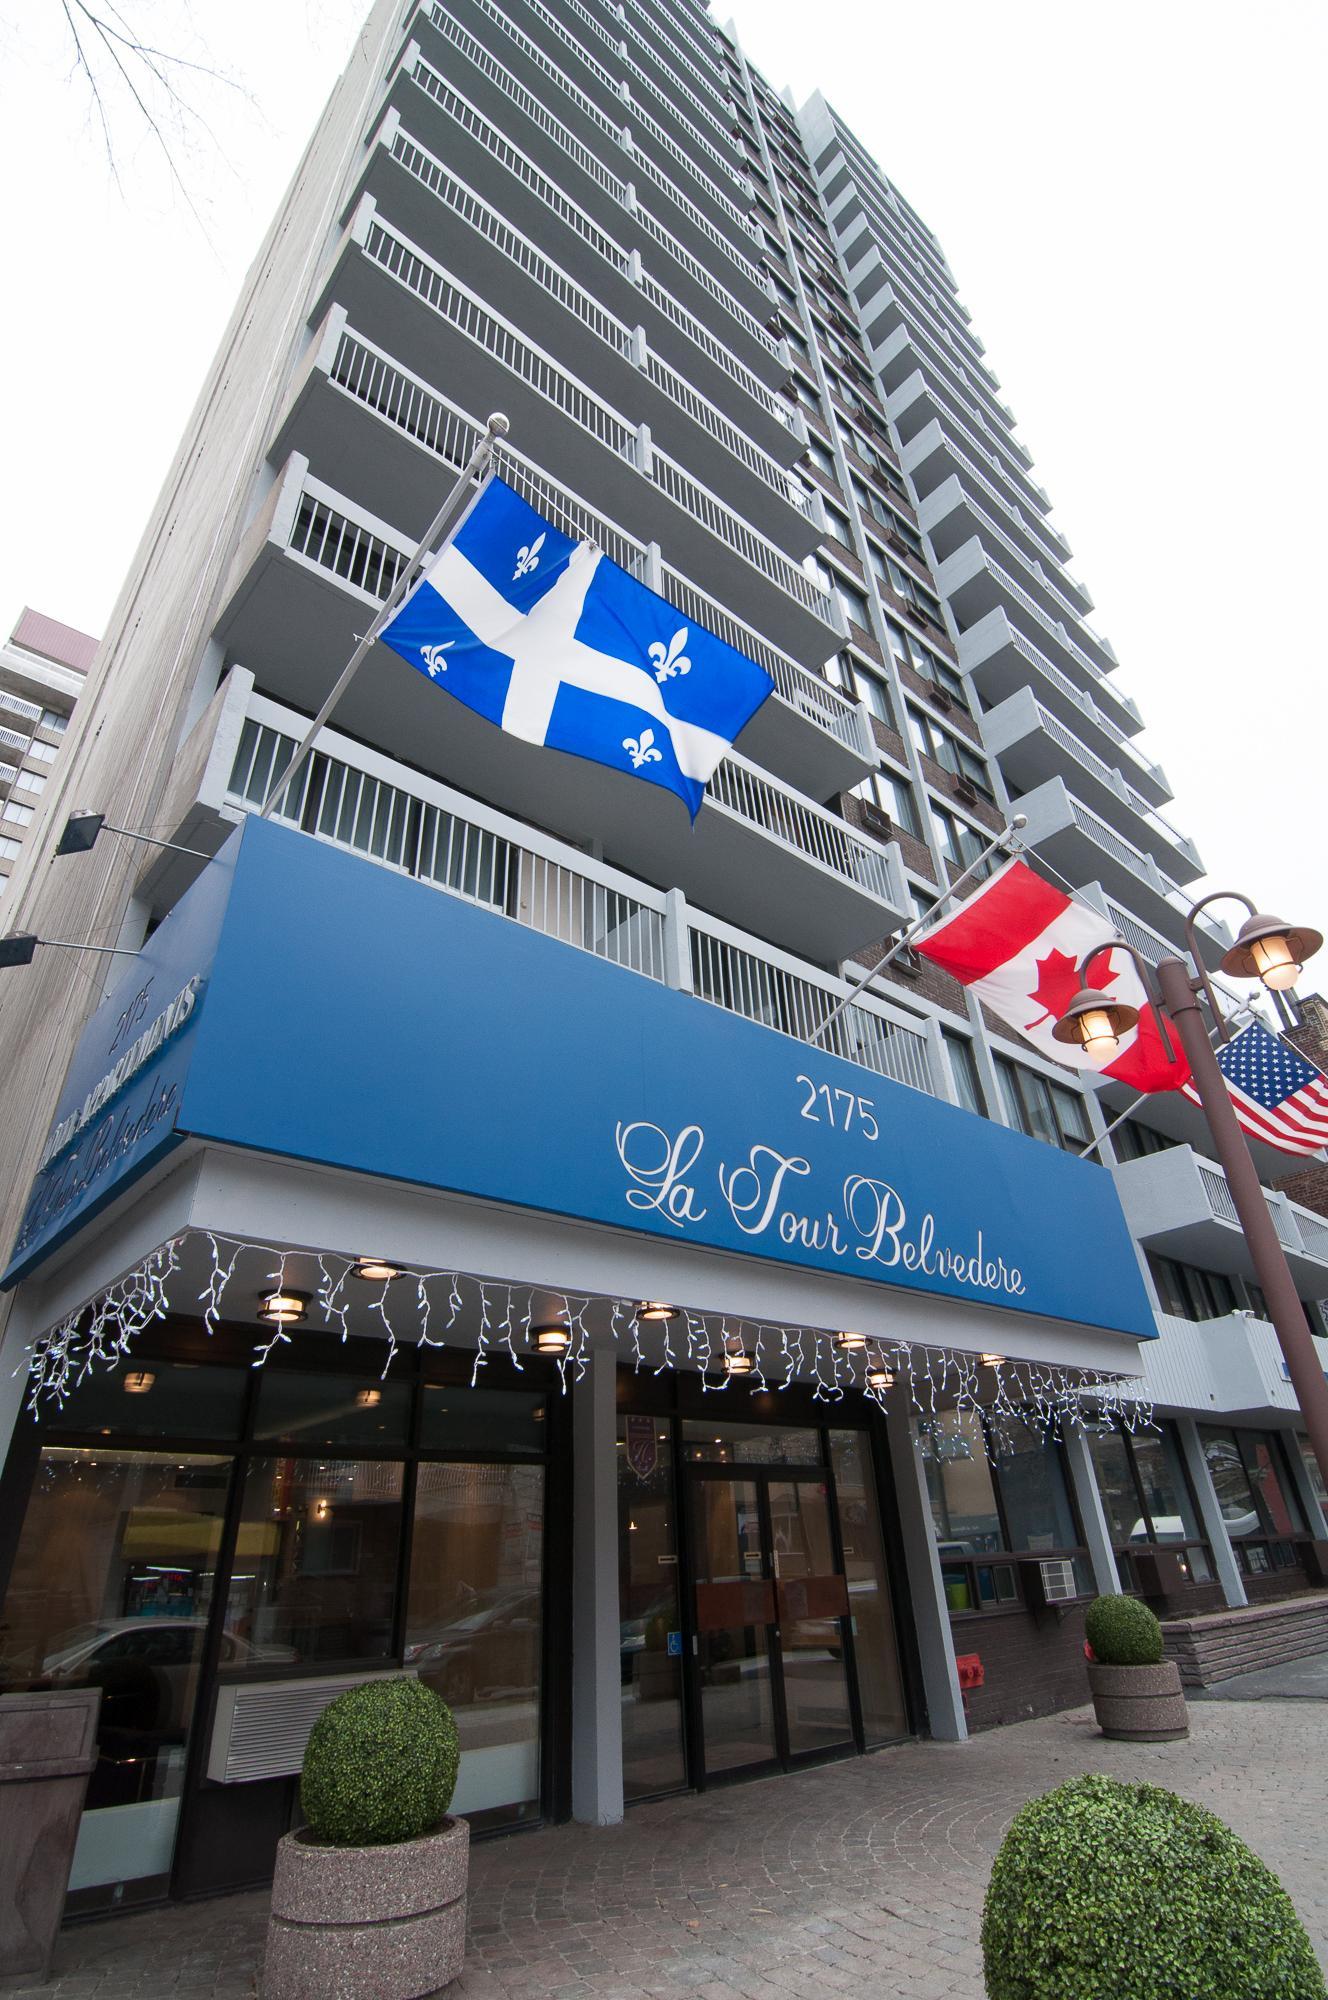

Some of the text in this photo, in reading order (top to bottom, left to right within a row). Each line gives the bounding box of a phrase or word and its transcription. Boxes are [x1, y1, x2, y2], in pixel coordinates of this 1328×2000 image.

[76, 1075, 178, 1192] Belvedere
[796, 1074, 879, 1141] 2175
[615, 1120, 1026, 1295] La Tour Belvedere
